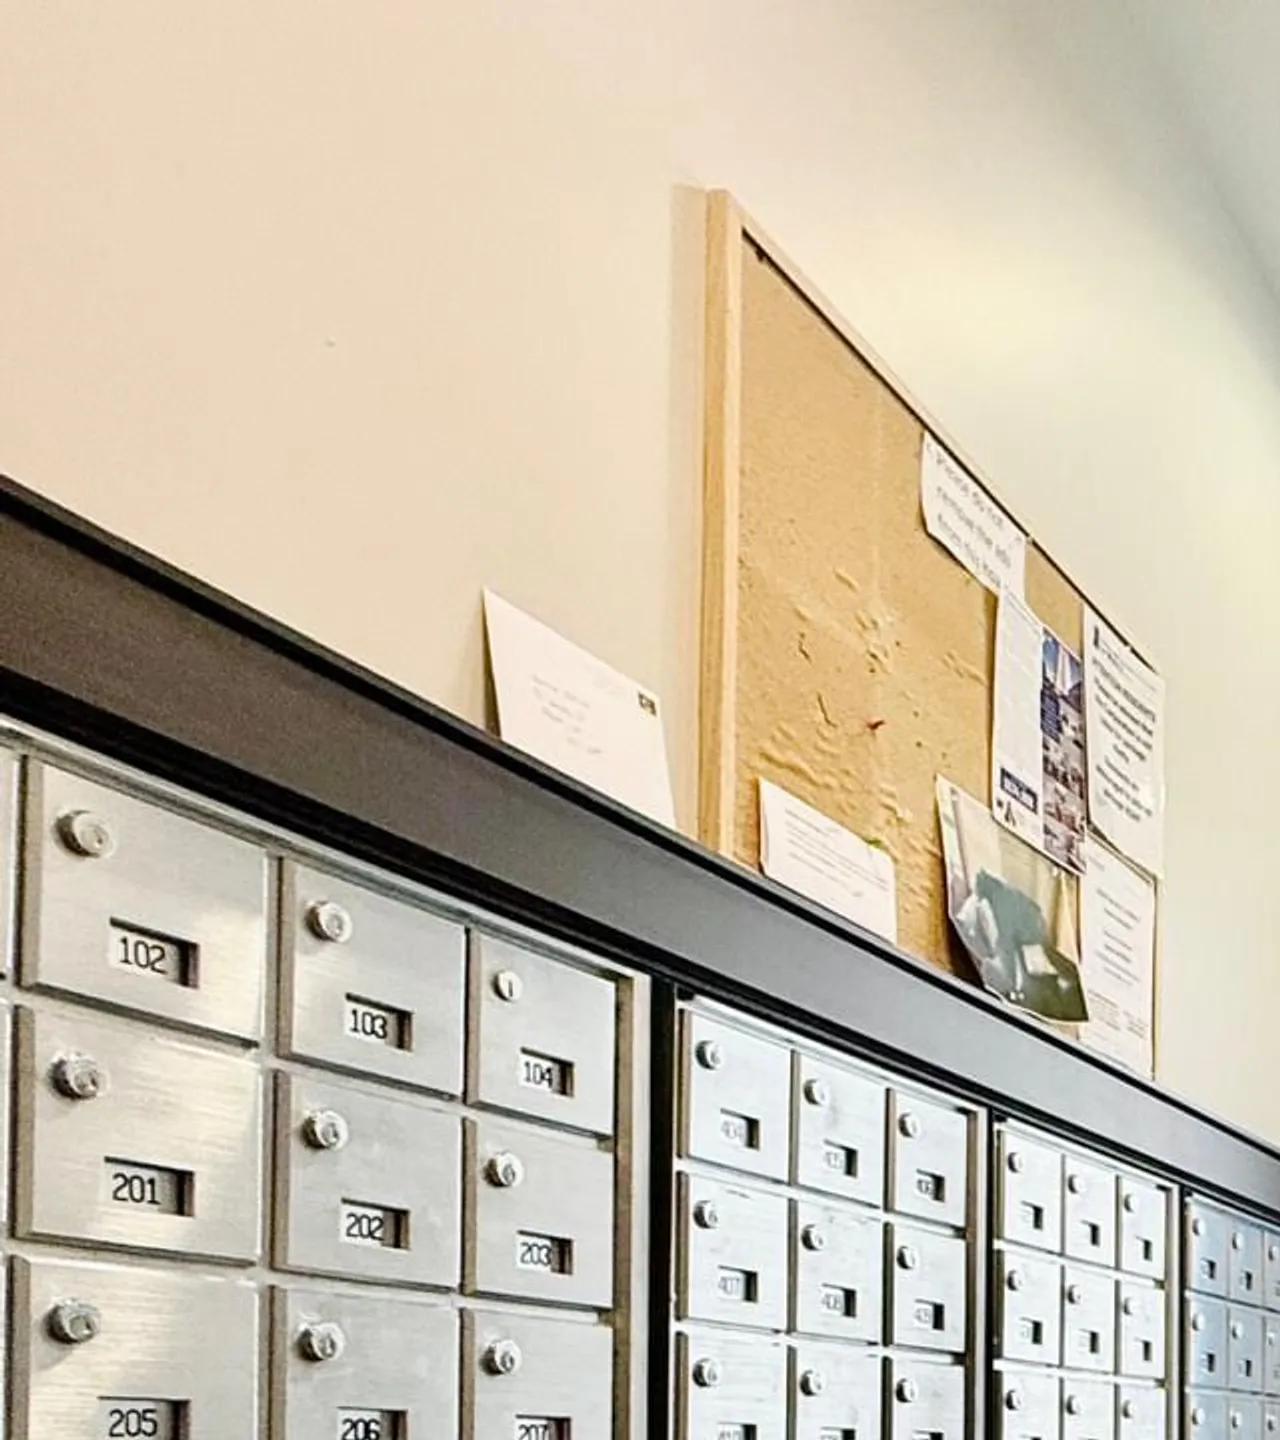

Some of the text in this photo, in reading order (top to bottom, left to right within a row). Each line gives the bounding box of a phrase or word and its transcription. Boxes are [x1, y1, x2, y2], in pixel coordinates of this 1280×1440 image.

[119, 936, 167, 975] 102
[350, 1008, 388, 1040] 103
[523, 1061, 553, 1089] 104
[112, 1172, 160, 1205] 201
[345, 1212, 385, 1241] 202
[519, 1242, 552, 1267] 203
[108, 1408, 158, 1437] 205
